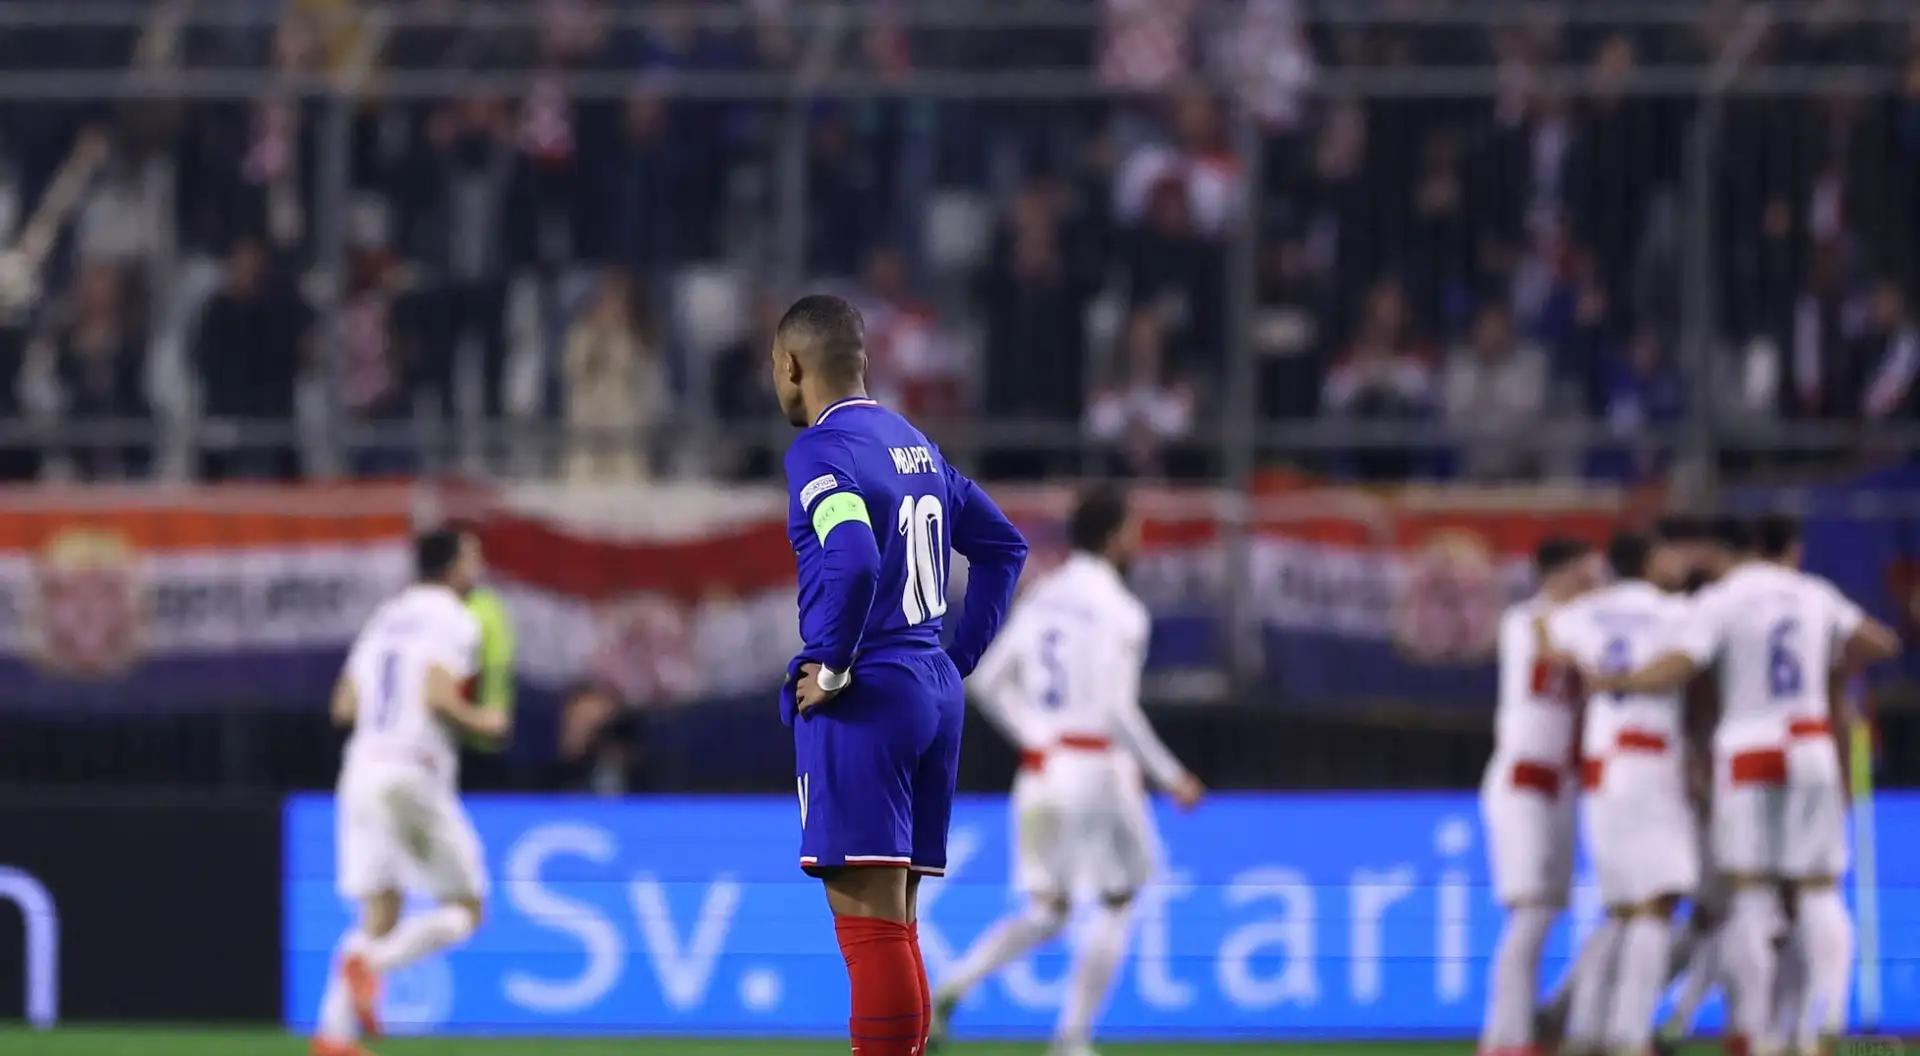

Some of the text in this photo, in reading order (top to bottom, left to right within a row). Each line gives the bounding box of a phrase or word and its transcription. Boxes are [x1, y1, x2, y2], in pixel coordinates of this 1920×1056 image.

[899, 494, 947, 627] 10
[1036, 627, 1071, 713] 5
[1766, 615, 1804, 701] 6
[504, 821, 785, 1013] Sv.
